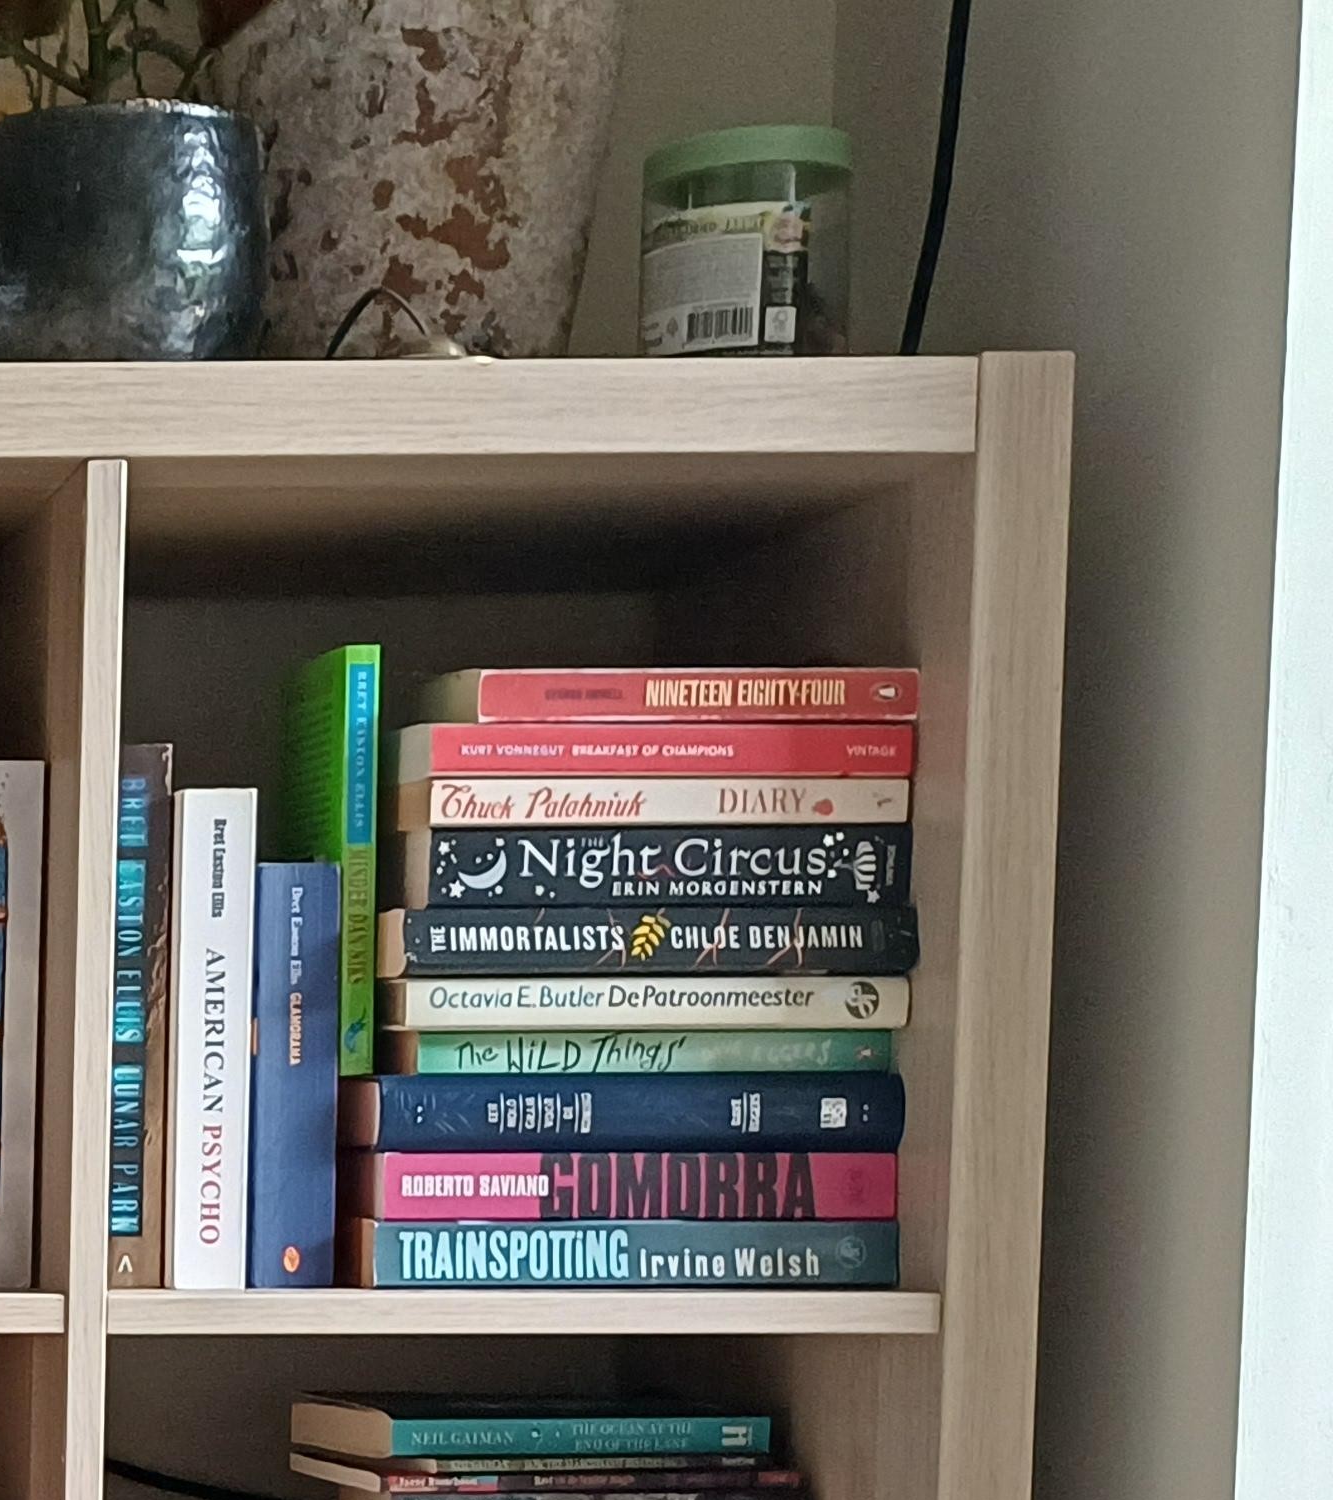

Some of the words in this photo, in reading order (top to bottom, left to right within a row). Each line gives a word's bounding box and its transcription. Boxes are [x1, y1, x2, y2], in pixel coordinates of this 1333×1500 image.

[719, 788, 807, 815] DIARY
[450, 925, 624, 951] IMMORTALISTS
[203, 948, 227, 1113] AMERICAN
[200, 1125, 223, 1245] PSYCHO
[639, 1248, 724, 1279] Irvine
[735, 1245, 821, 1279] Welsh
